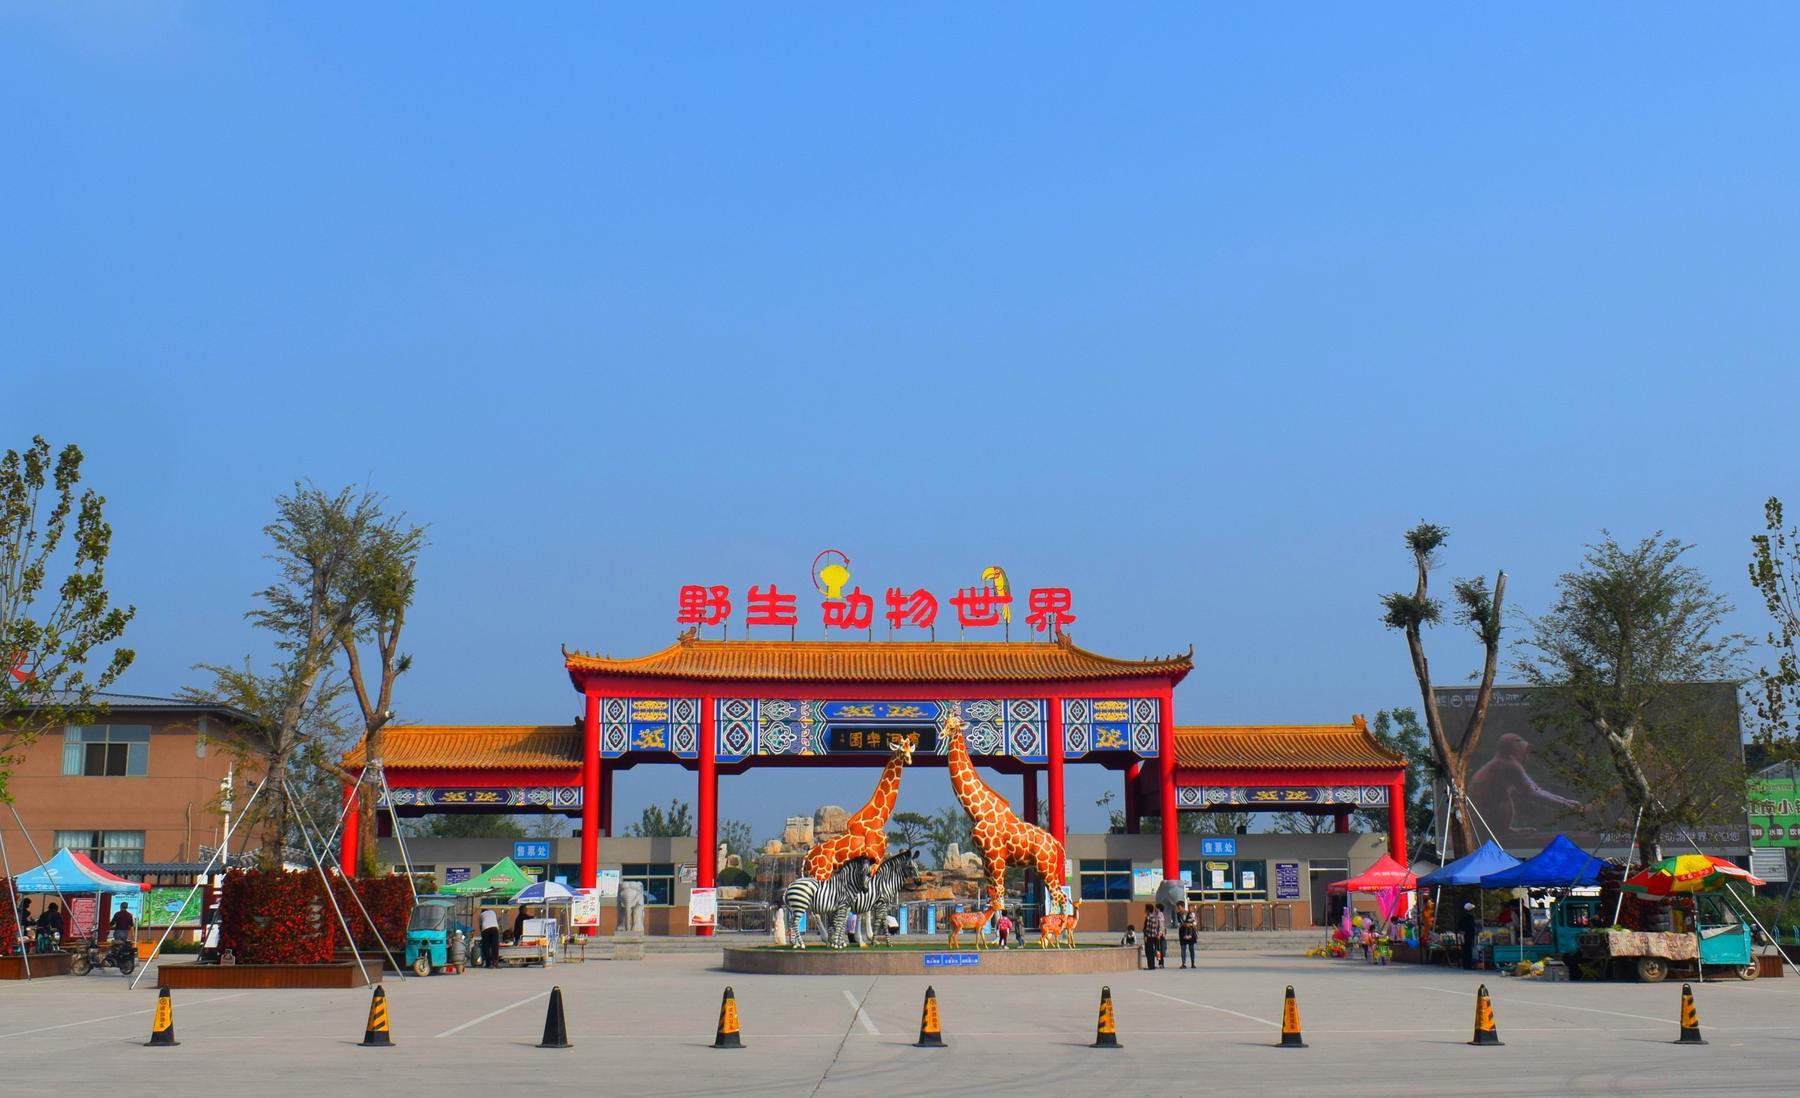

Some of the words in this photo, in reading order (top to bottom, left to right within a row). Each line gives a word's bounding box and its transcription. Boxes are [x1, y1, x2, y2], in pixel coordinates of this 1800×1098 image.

[677, 583, 1076, 632] 野生动物世界
[517, 845, 546, 857] 售票处
[1205, 841, 1233, 853] 售票处
